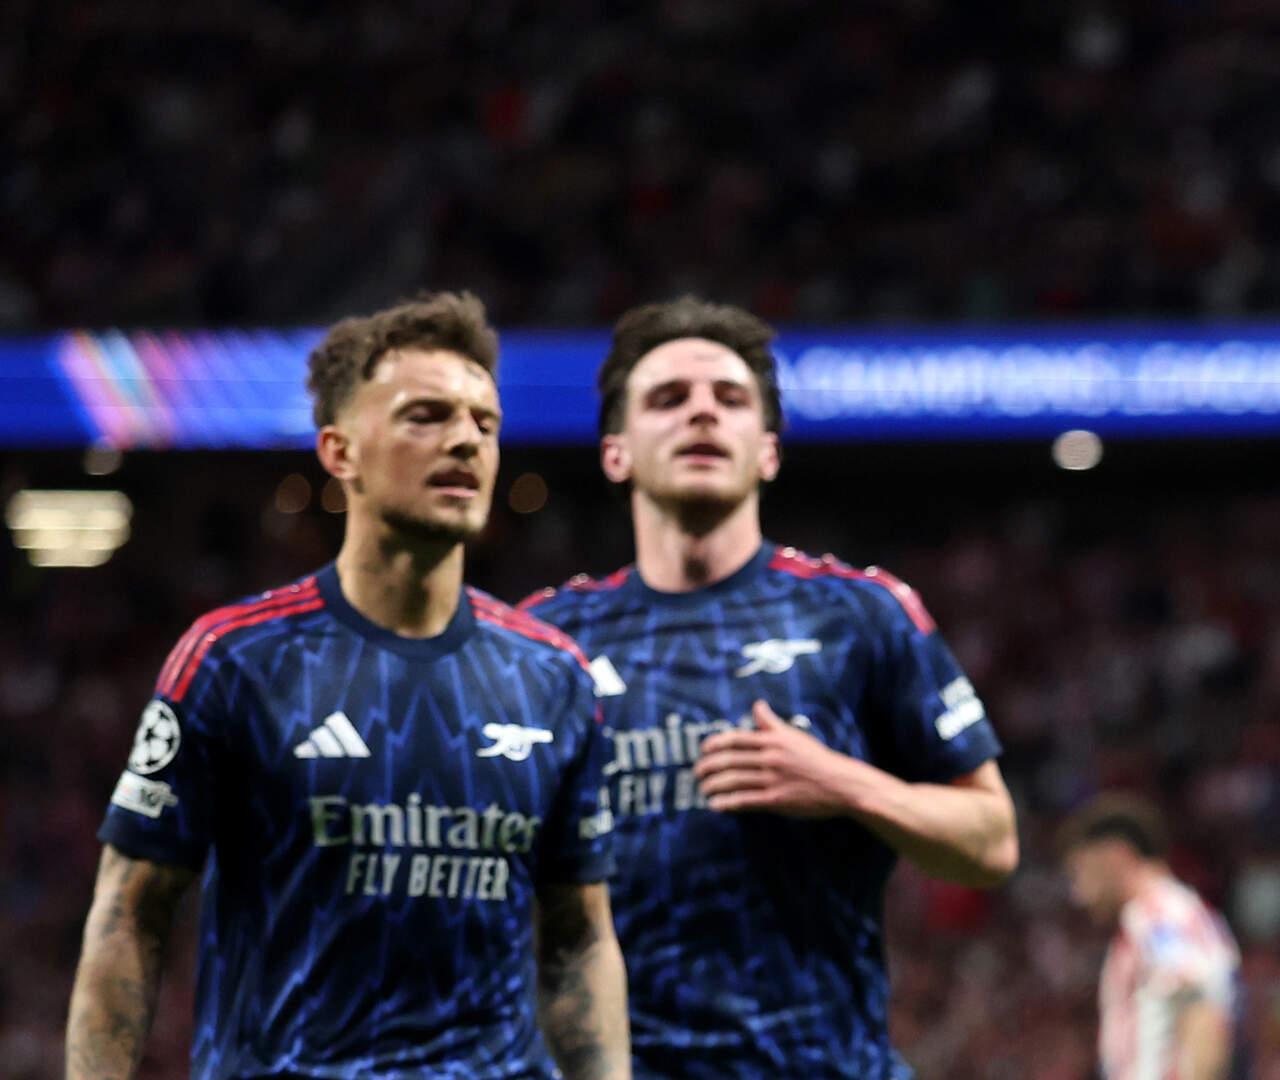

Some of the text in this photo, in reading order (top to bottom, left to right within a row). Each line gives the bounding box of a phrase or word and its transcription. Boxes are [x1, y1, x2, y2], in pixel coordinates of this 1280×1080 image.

[309, 792, 543, 852] Emirates
[346, 853, 509, 901] FLY BETTER
